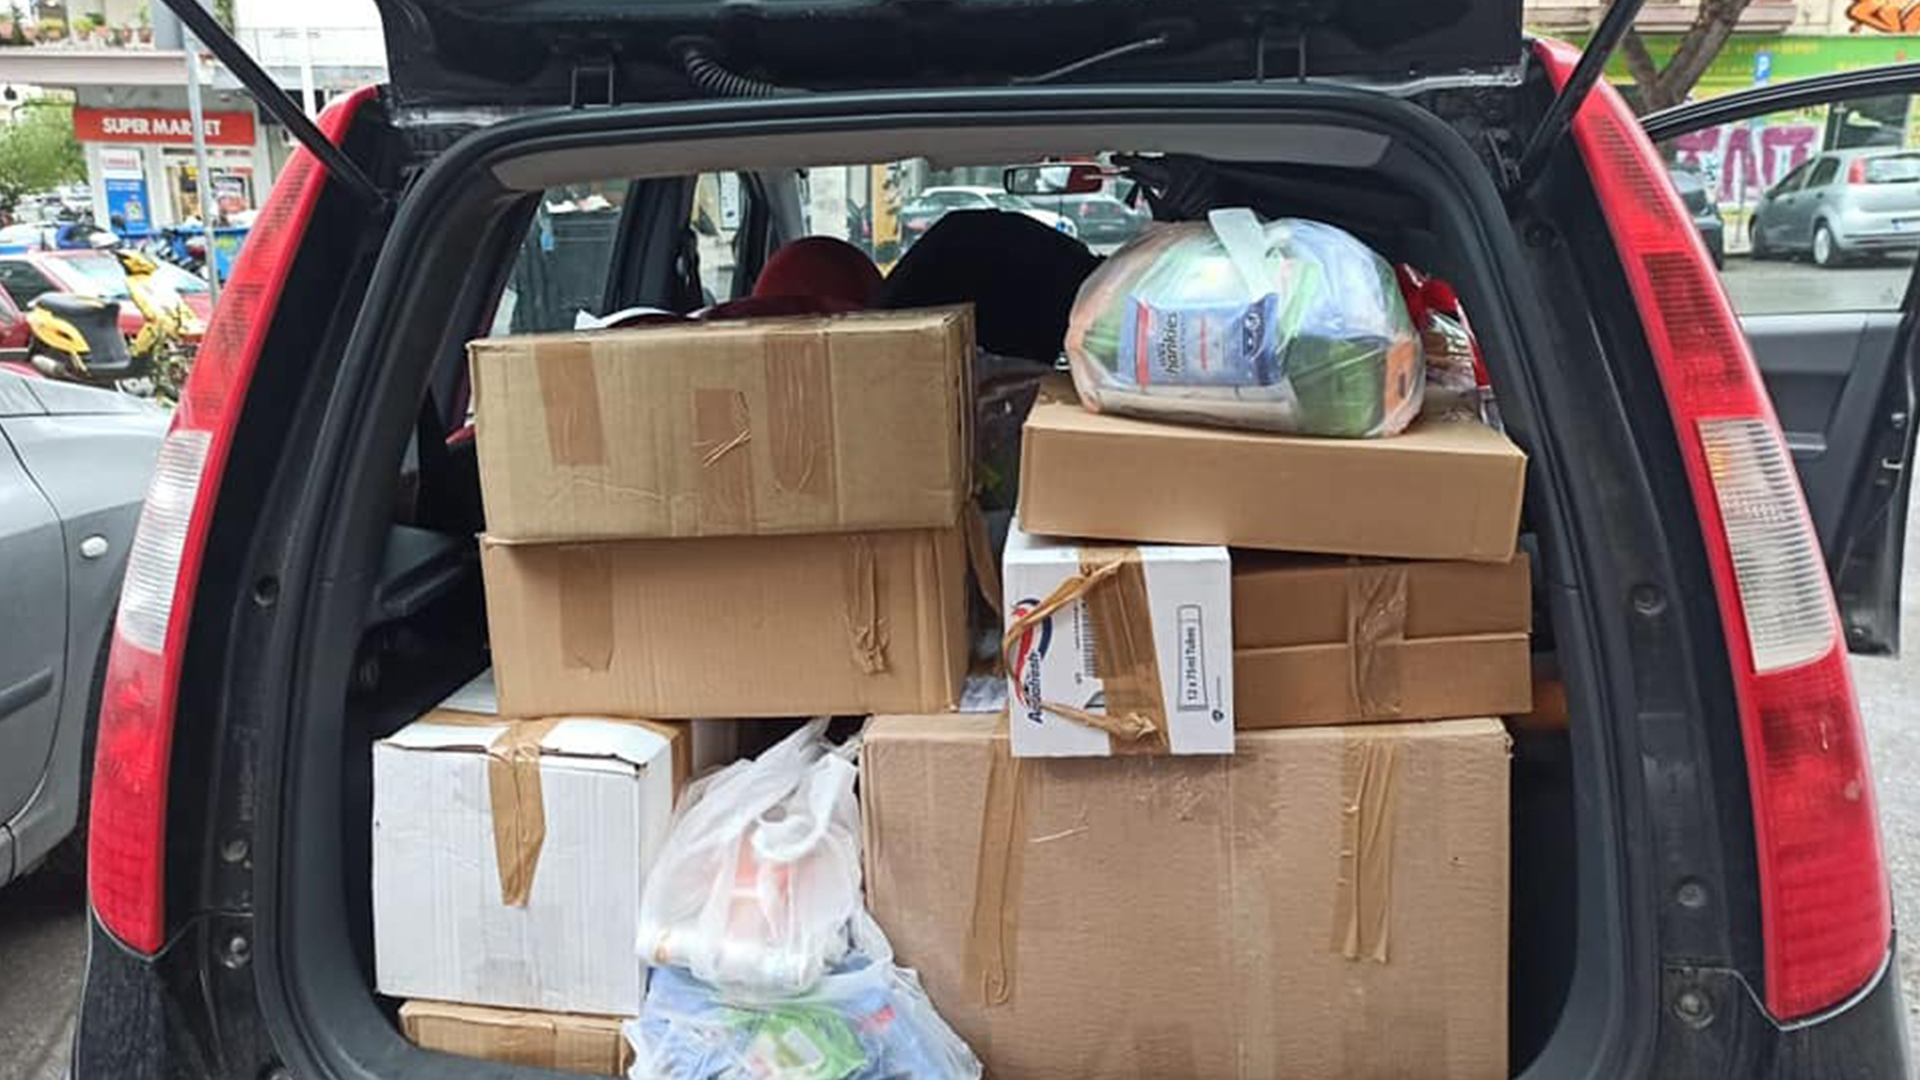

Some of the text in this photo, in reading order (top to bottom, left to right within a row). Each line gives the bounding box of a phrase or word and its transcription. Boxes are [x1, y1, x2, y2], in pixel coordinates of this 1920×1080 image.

[102, 118, 222, 136] SUPER MARET
[1184, 627, 1196, 655] Tubes
[1185, 656, 1197, 681] 75ml
[1187, 689, 1198, 700] 12
